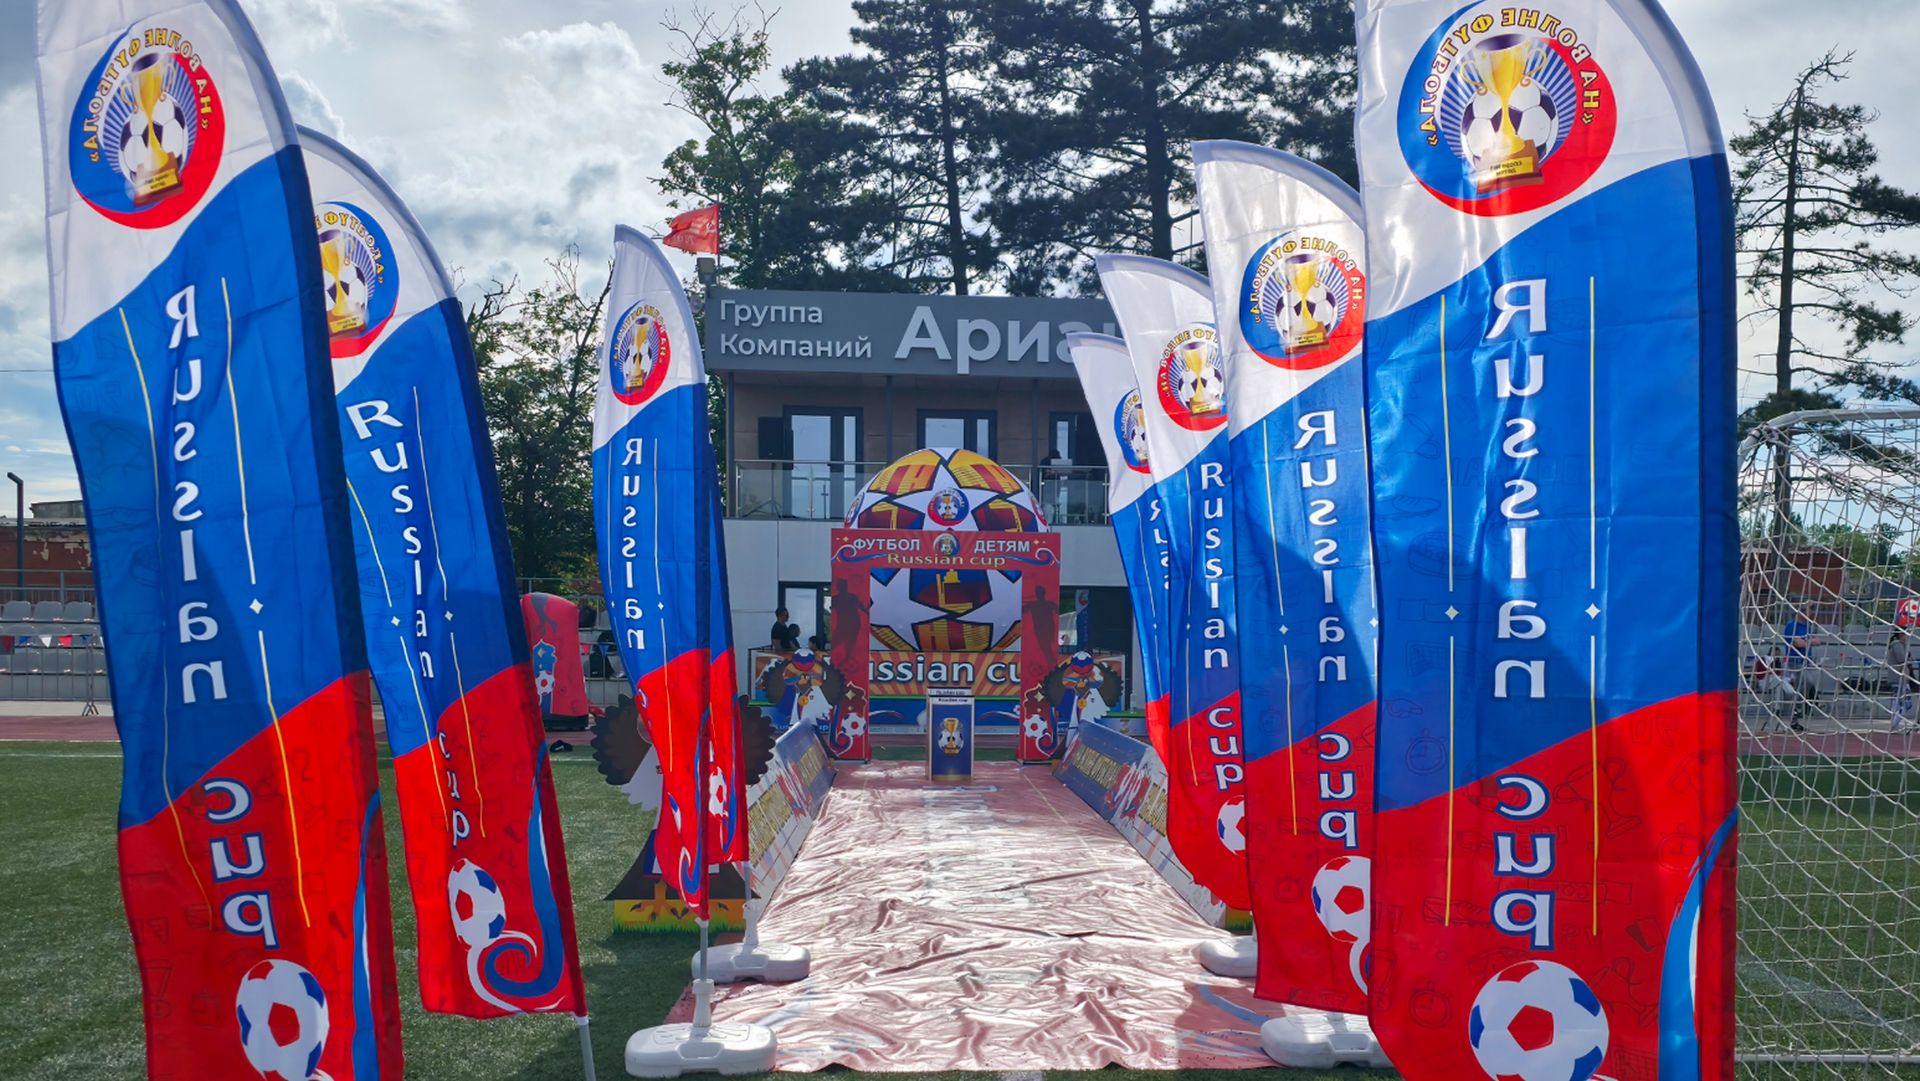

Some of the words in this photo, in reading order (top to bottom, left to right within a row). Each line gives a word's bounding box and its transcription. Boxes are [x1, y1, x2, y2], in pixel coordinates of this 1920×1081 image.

[720, 299, 823, 327] Группа
[720, 333, 872, 359] Компаний
[853, 538, 920, 551] ФУТБОЛ
[974, 540, 1030, 553] ДЕТЯМ
[887, 553, 964, 565] Russian
[969, 555, 1006, 567] cup
[1201, 461, 1231, 671] Russian
[346, 398, 435, 680] Russian
[437, 730, 471, 848] cup
[1206, 704, 1244, 791] cup
